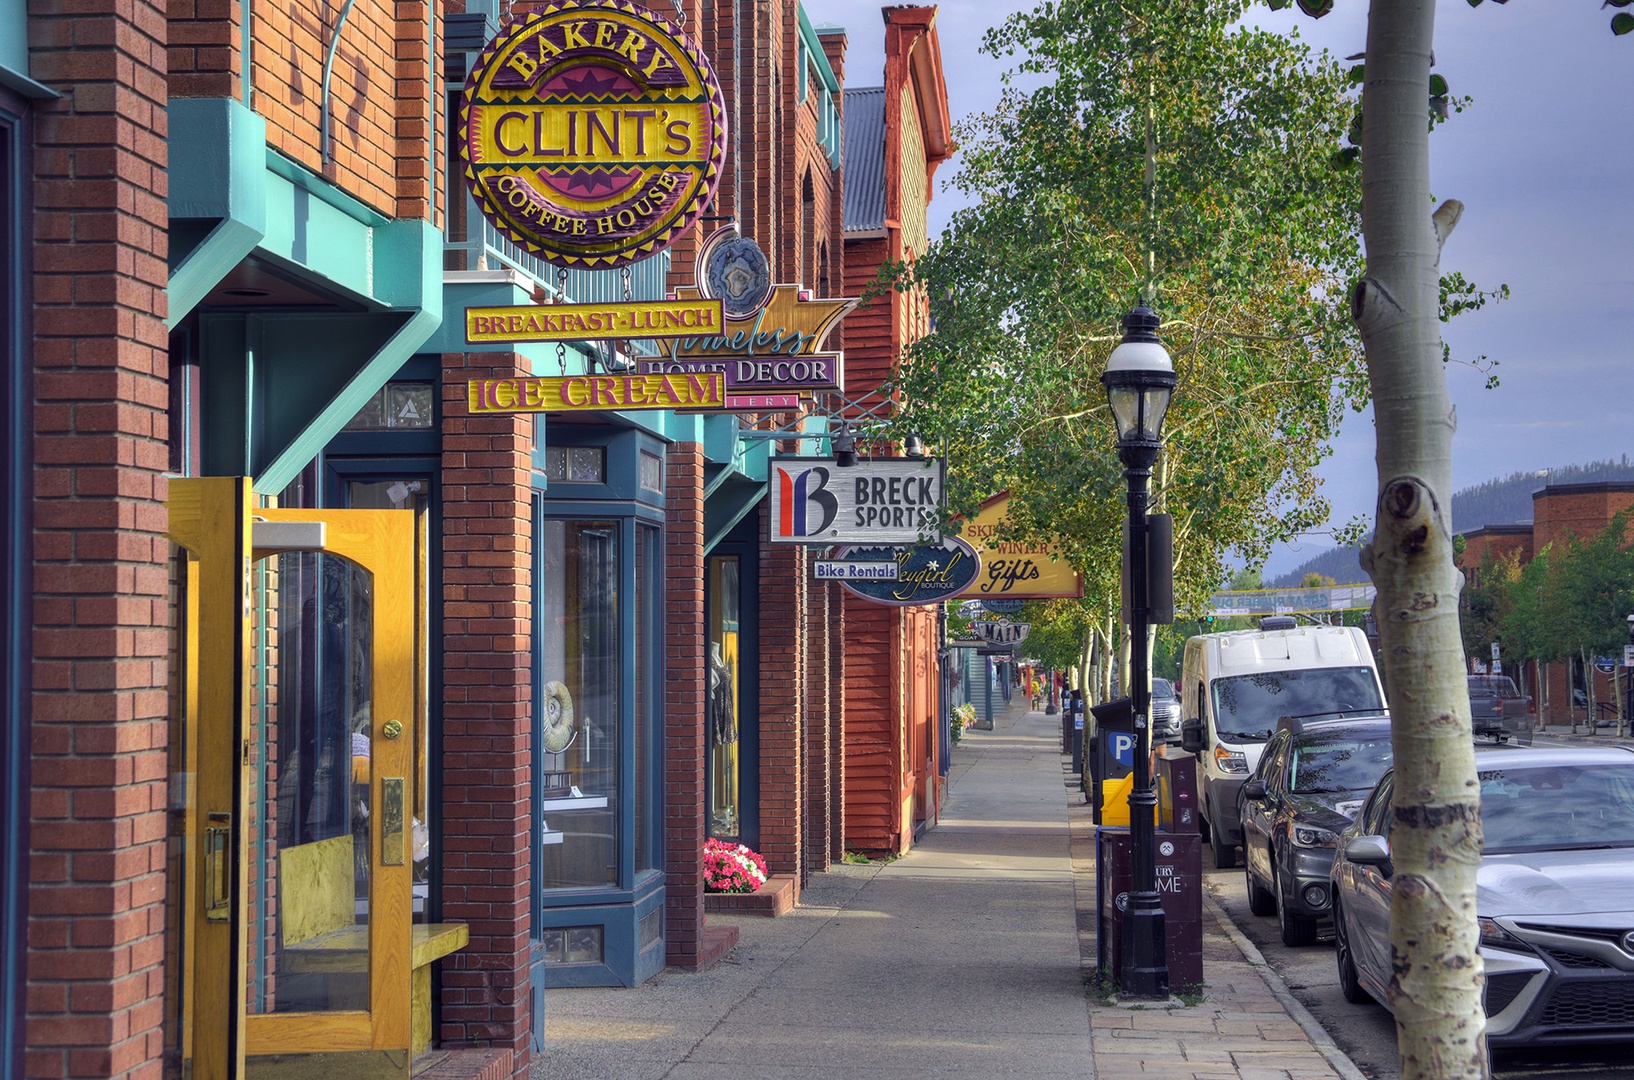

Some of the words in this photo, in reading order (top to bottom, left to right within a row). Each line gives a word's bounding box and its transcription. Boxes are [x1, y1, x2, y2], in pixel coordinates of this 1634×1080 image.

[506, 20, 673, 82] BAKERY
[496, 175, 588, 237] COFFEE
[595, 173, 680, 236] HOUSE
[736, 360, 828, 382] DECOR
[476, 378, 546, 410] ICE
[560, 373, 723, 407] CREAM
[733, 396, 790, 407] LERY
[855, 476, 935, 505] BRECK
[855, 506, 928, 527] SPORTS
[817, 563, 845, 577] Bike
[849, 563, 895, 578] Rentals
[980, 559, 1040, 593] Gifts
[985, 624, 1022, 643] MAIN
[1115, 735, 1132, 760] P
[1154, 876, 1182, 893] ME
